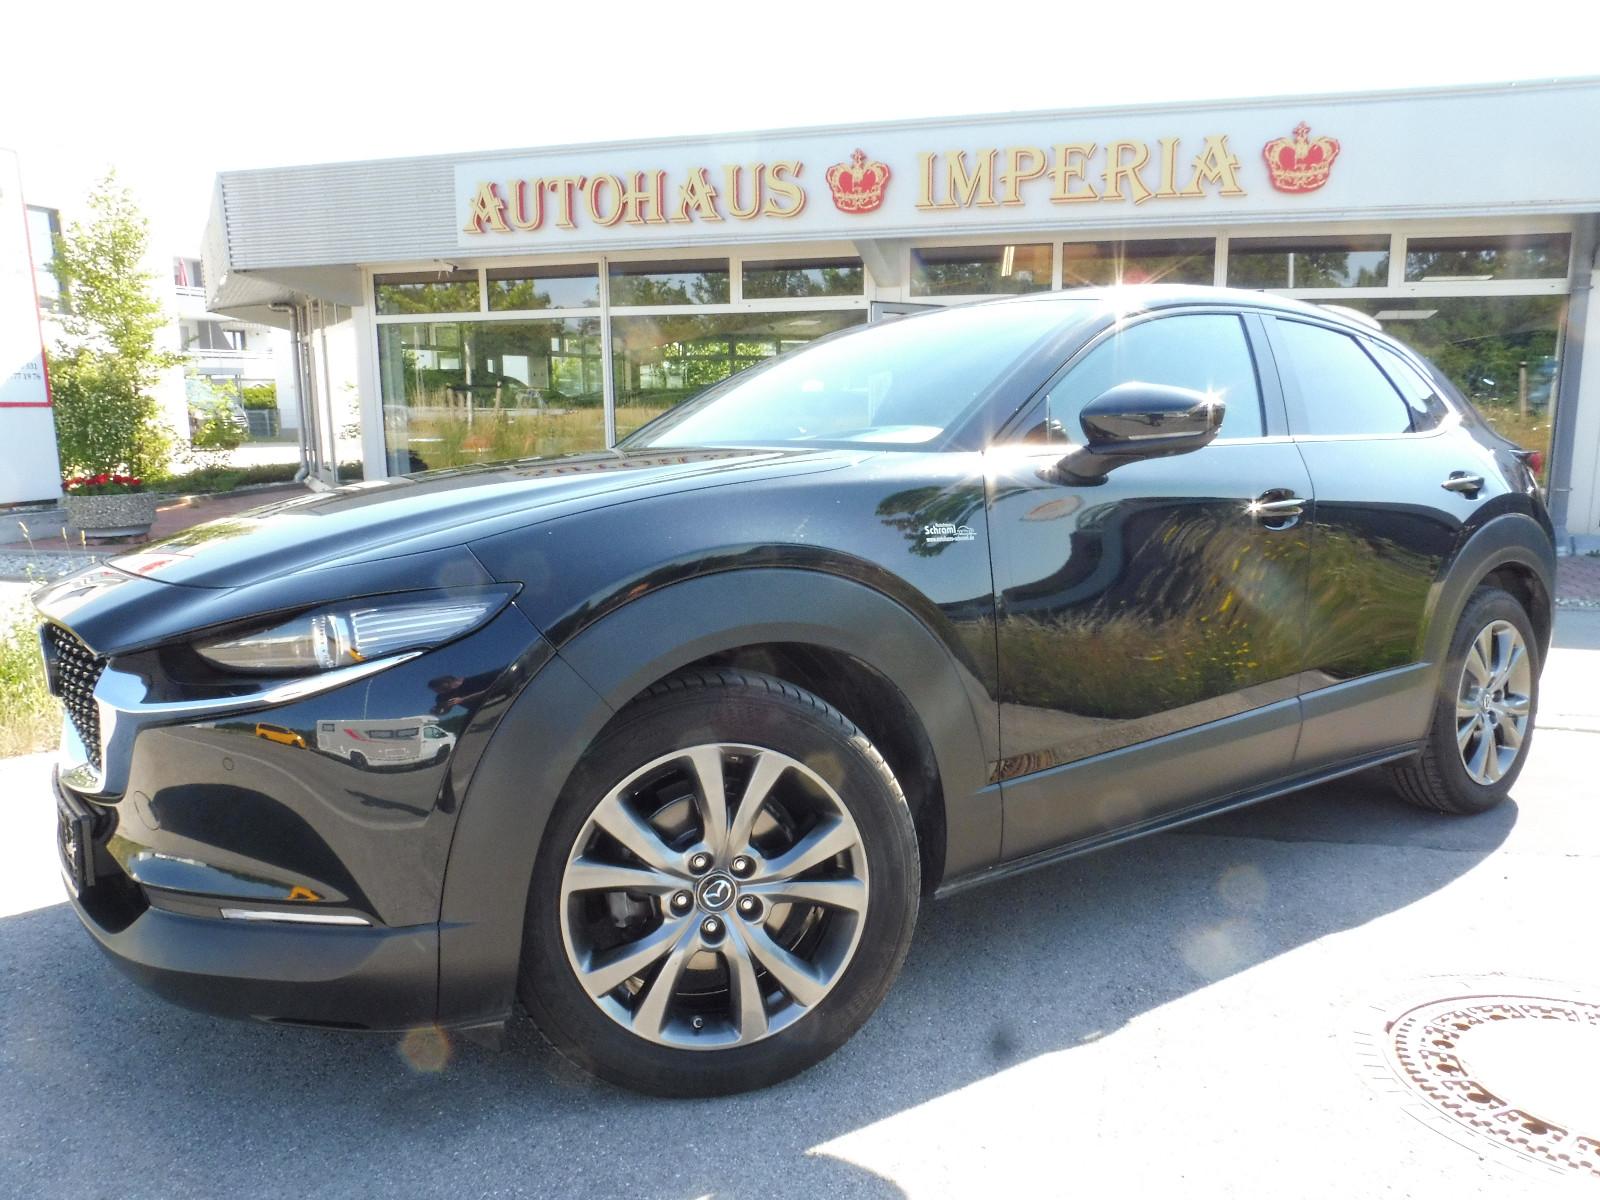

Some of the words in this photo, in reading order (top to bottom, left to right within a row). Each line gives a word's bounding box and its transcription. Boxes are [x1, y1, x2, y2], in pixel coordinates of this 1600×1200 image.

[463, 161, 807, 234] AUTOHAUS
[915, 134, 1246, 209] IMPERIA
[924, 524, 956, 535] Schraml
